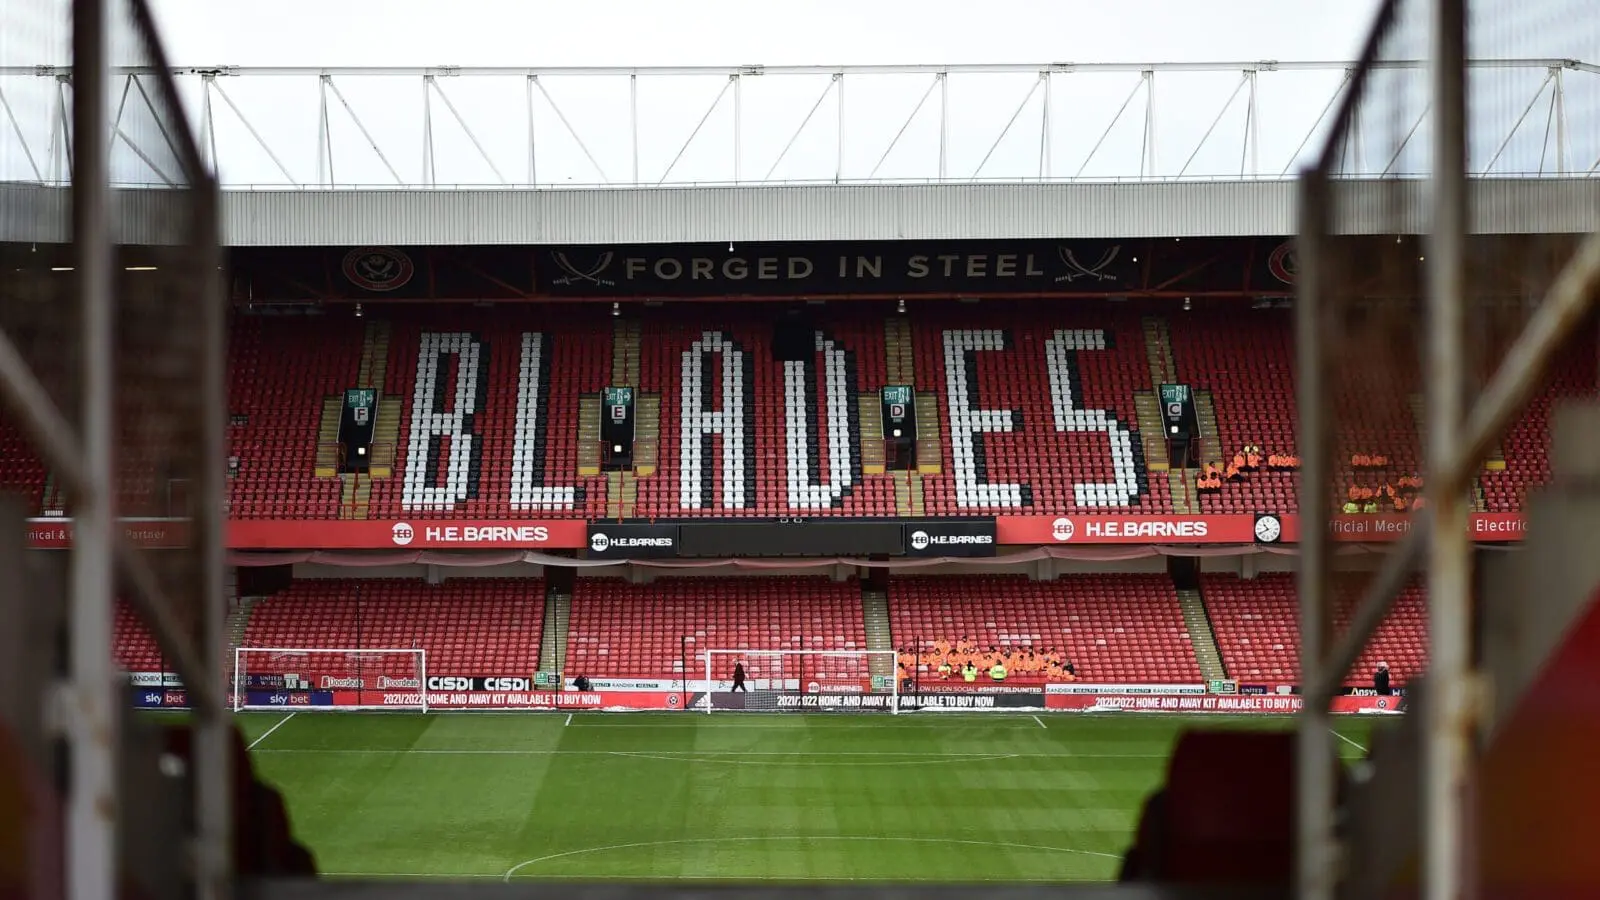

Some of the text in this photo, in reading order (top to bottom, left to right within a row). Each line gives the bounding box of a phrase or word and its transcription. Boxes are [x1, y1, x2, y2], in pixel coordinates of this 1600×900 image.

[625, 253, 1044, 281] FORGED IN STEEL
[357, 408, 366, 420] F
[614, 406, 624, 418] E
[891, 405, 903, 417] D
[1169, 403, 1181, 415] C
[1086, 521, 1208, 537] H.E.BARNES
[1330, 520, 1369, 533] fficial
[1476, 518, 1528, 533] Electric
[27, 530, 55, 540] nical
[125, 529, 166, 540] Partner
[426, 526, 549, 542] H.E.BARNES
[930, 535, 993, 545] H.E.BARNES
[610, 537, 673, 547] H.E.BARNES
[427, 676, 473, 691] CISDI
[484, 677, 530, 691] CISDI
[145, 693, 185, 705] sky bet
[270, 693, 309, 705] sky bet
[383, 693, 423, 706] 2021/2022
[450, 694, 467, 705] AND
[468, 694, 491, 705] AWAY
[492, 694, 506, 705] KIT
[507, 694, 549, 705] AVAILABLE
[551, 694, 563, 705] TO
[563, 694, 585, 705] BUY
[585, 694, 602, 705] NOW
[819, 695, 842, 707] HOME
[843, 695, 861, 707] AND
[861, 695, 885, 707] AWAY
[900, 695, 944, 707] AVAILABLE
[944, 695, 957, 707] TO
[956, 695, 974, 707] BUY
[974, 695, 995, 707] NOW
[1136, 697, 1160, 708] HOME
[1160, 697, 1179, 708] AND
[1179, 697, 1203, 709] AWAY
[1203, 697, 1217, 709] KIT
[1217, 697, 1261, 709] AVAILABLE
[1262, 697, 1274, 709] TO
[1274, 697, 1290, 709] BUY
[1291, 697, 1304, 710] NO
